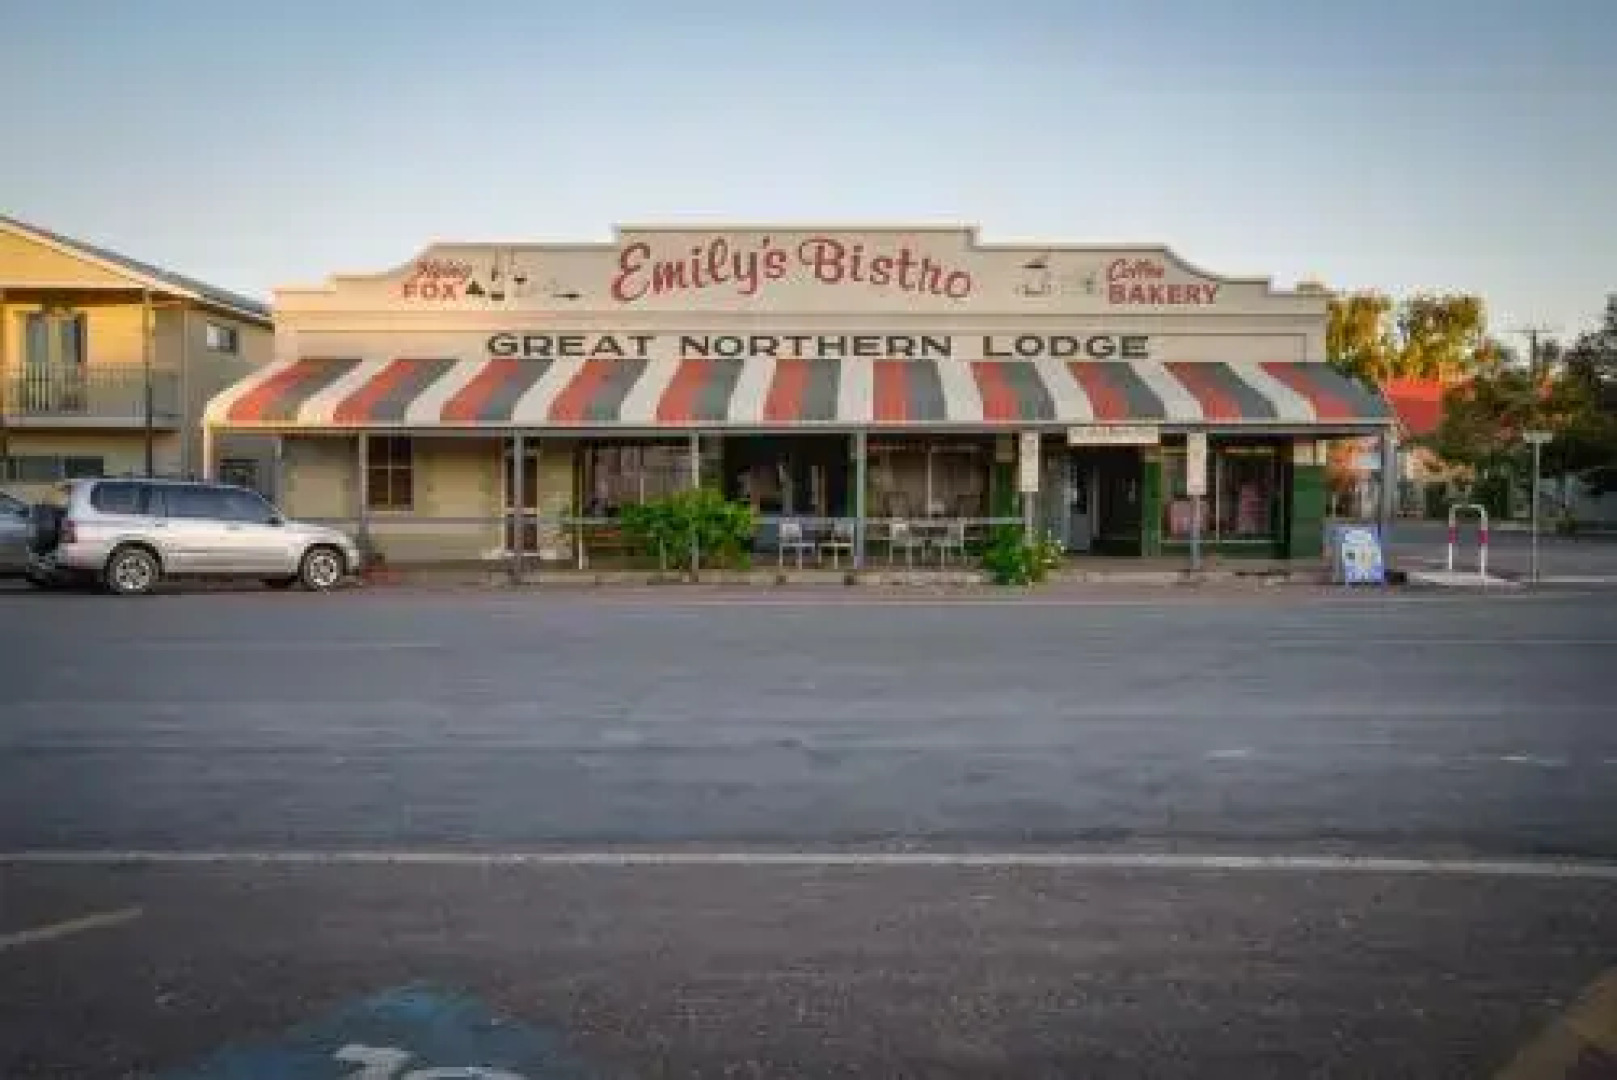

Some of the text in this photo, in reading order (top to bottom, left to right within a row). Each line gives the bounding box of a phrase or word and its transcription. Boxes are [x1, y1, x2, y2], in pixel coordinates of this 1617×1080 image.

[610, 236, 973, 302] Emily's Bistro
[403, 283, 457, 299] FOX
[1108, 284, 1217, 305] BAKERY
[487, 334, 1150, 358] GREAT NORTHERN LODGE
